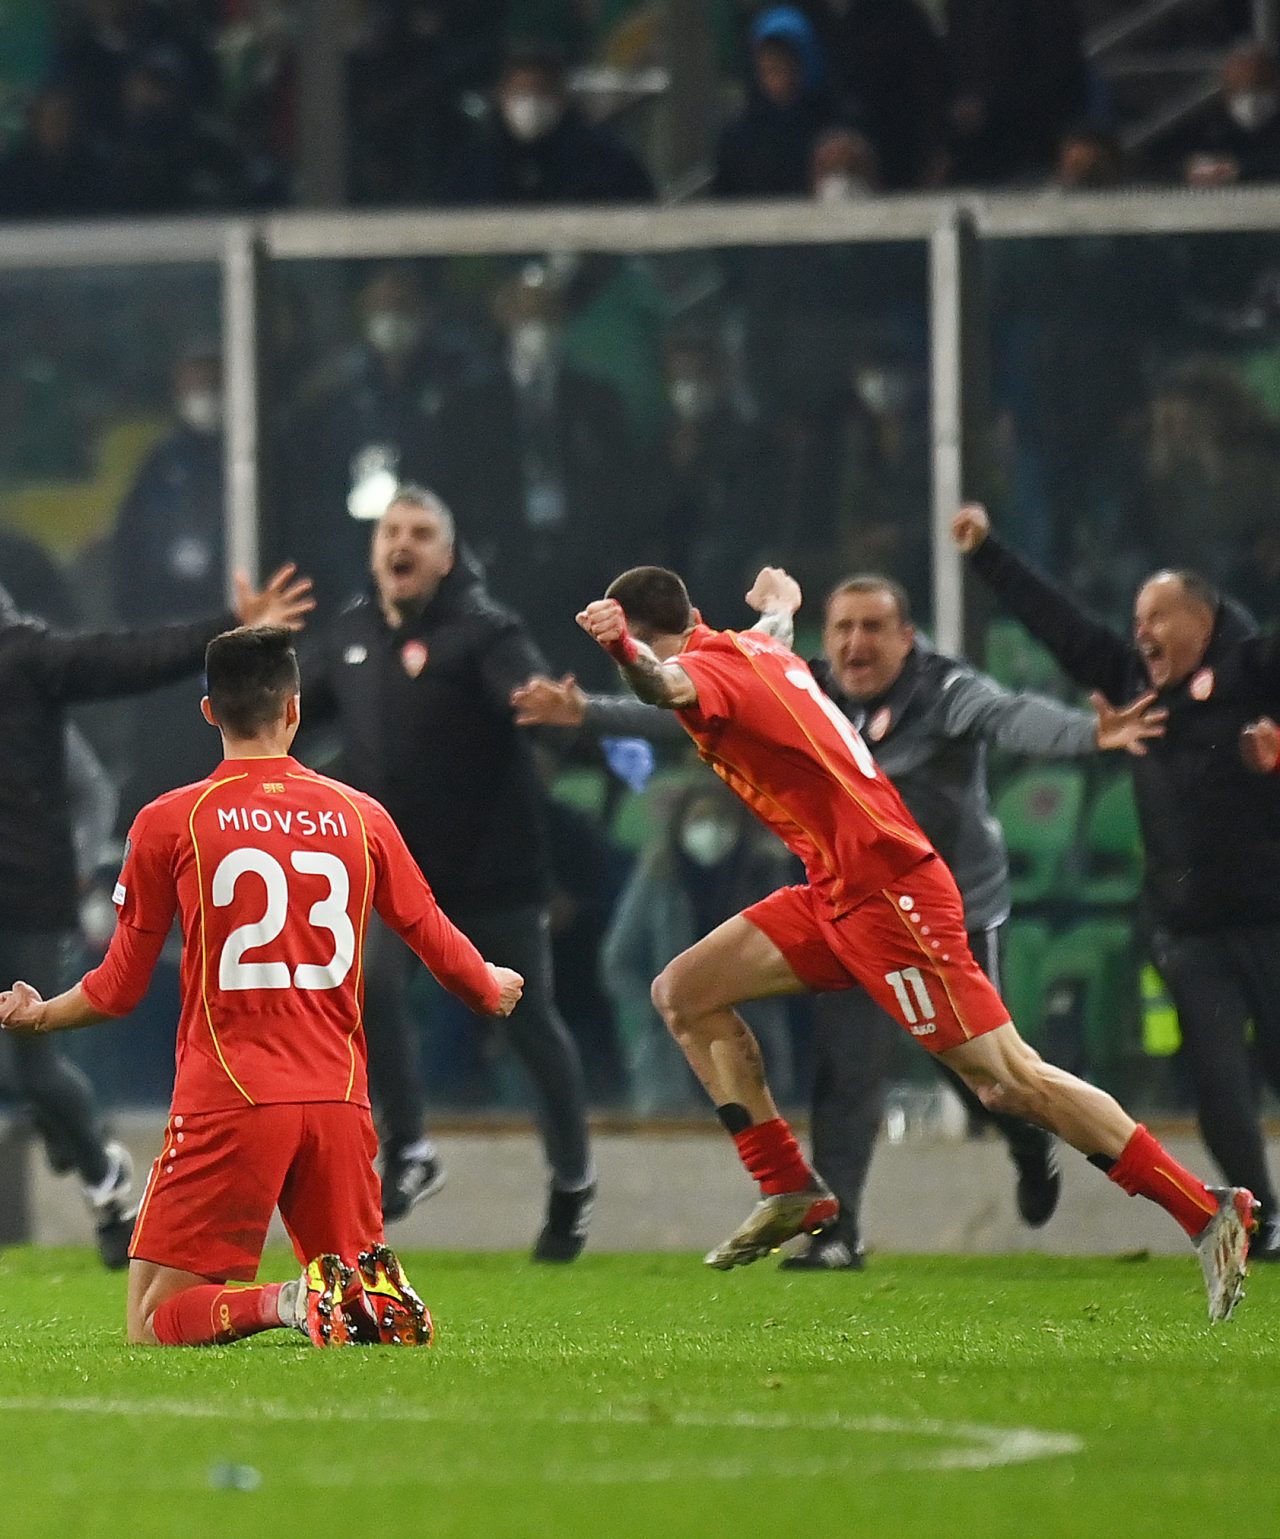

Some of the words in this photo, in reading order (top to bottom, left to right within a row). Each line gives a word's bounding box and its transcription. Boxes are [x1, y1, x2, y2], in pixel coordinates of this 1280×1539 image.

[217, 807, 348, 837] MIOVSKI
[212, 847, 356, 991] 23
[884, 966, 936, 1024] 11
